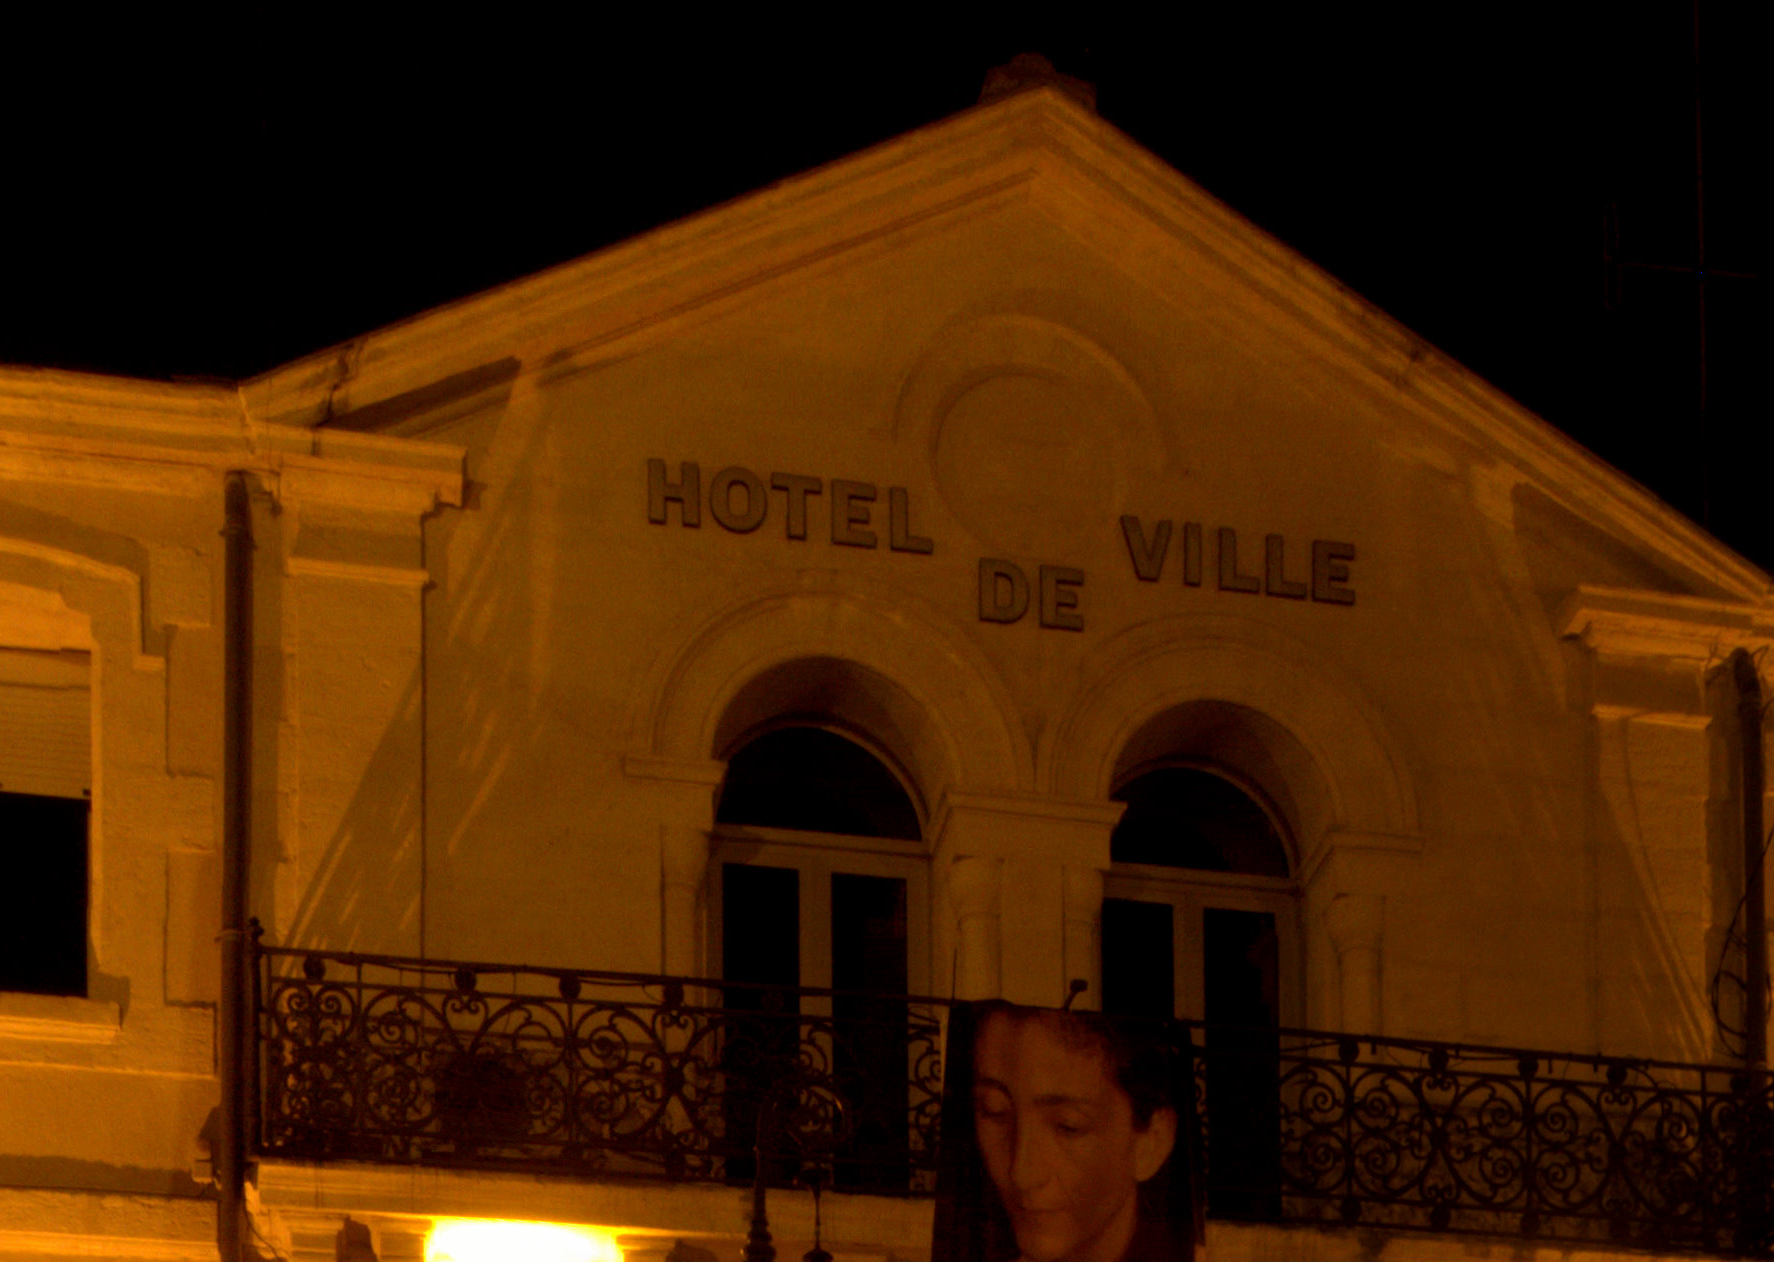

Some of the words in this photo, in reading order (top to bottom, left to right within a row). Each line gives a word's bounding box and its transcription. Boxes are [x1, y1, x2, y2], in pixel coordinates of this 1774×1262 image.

[647, 458, 934, 555] HOTEL
[978, 557, 1085, 632] DE
[1120, 514, 1356, 606] VILLE
